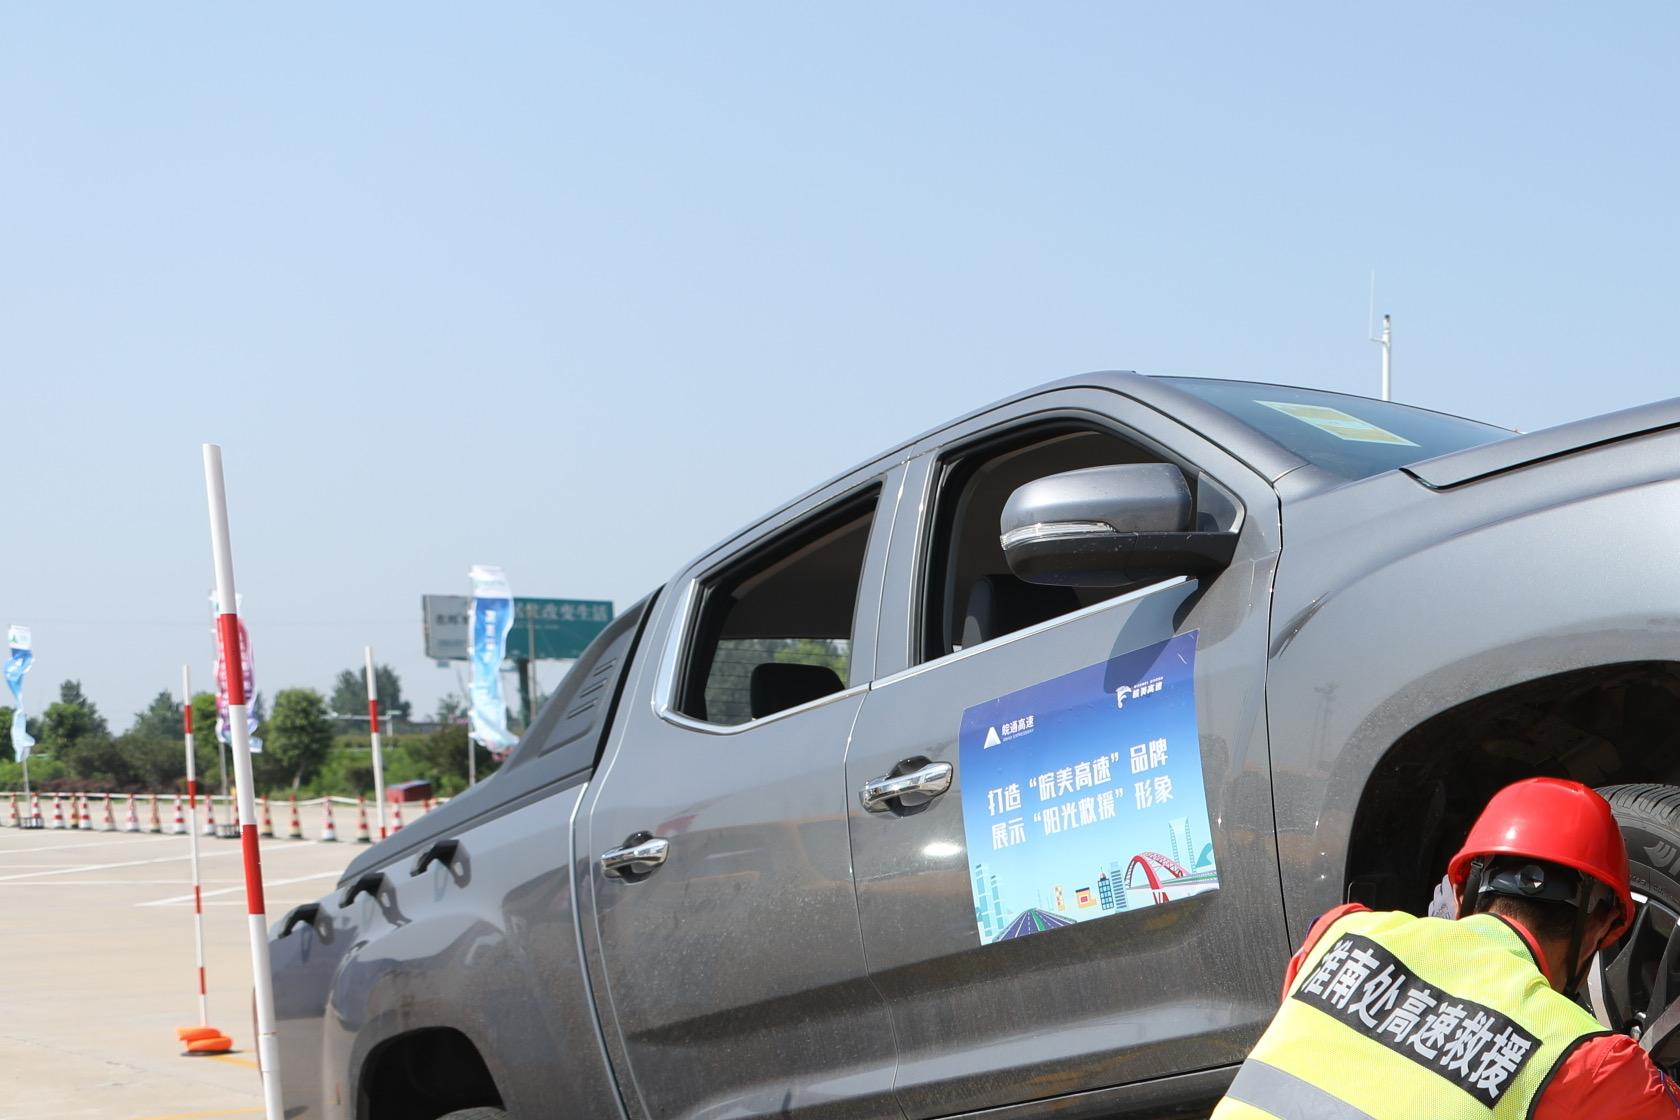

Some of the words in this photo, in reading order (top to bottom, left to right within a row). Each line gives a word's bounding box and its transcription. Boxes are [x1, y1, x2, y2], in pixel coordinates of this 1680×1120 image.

[1002, 715, 1035, 736] 皖通高速
[1301, 939, 1533, 1100] 淮南处高速救援
